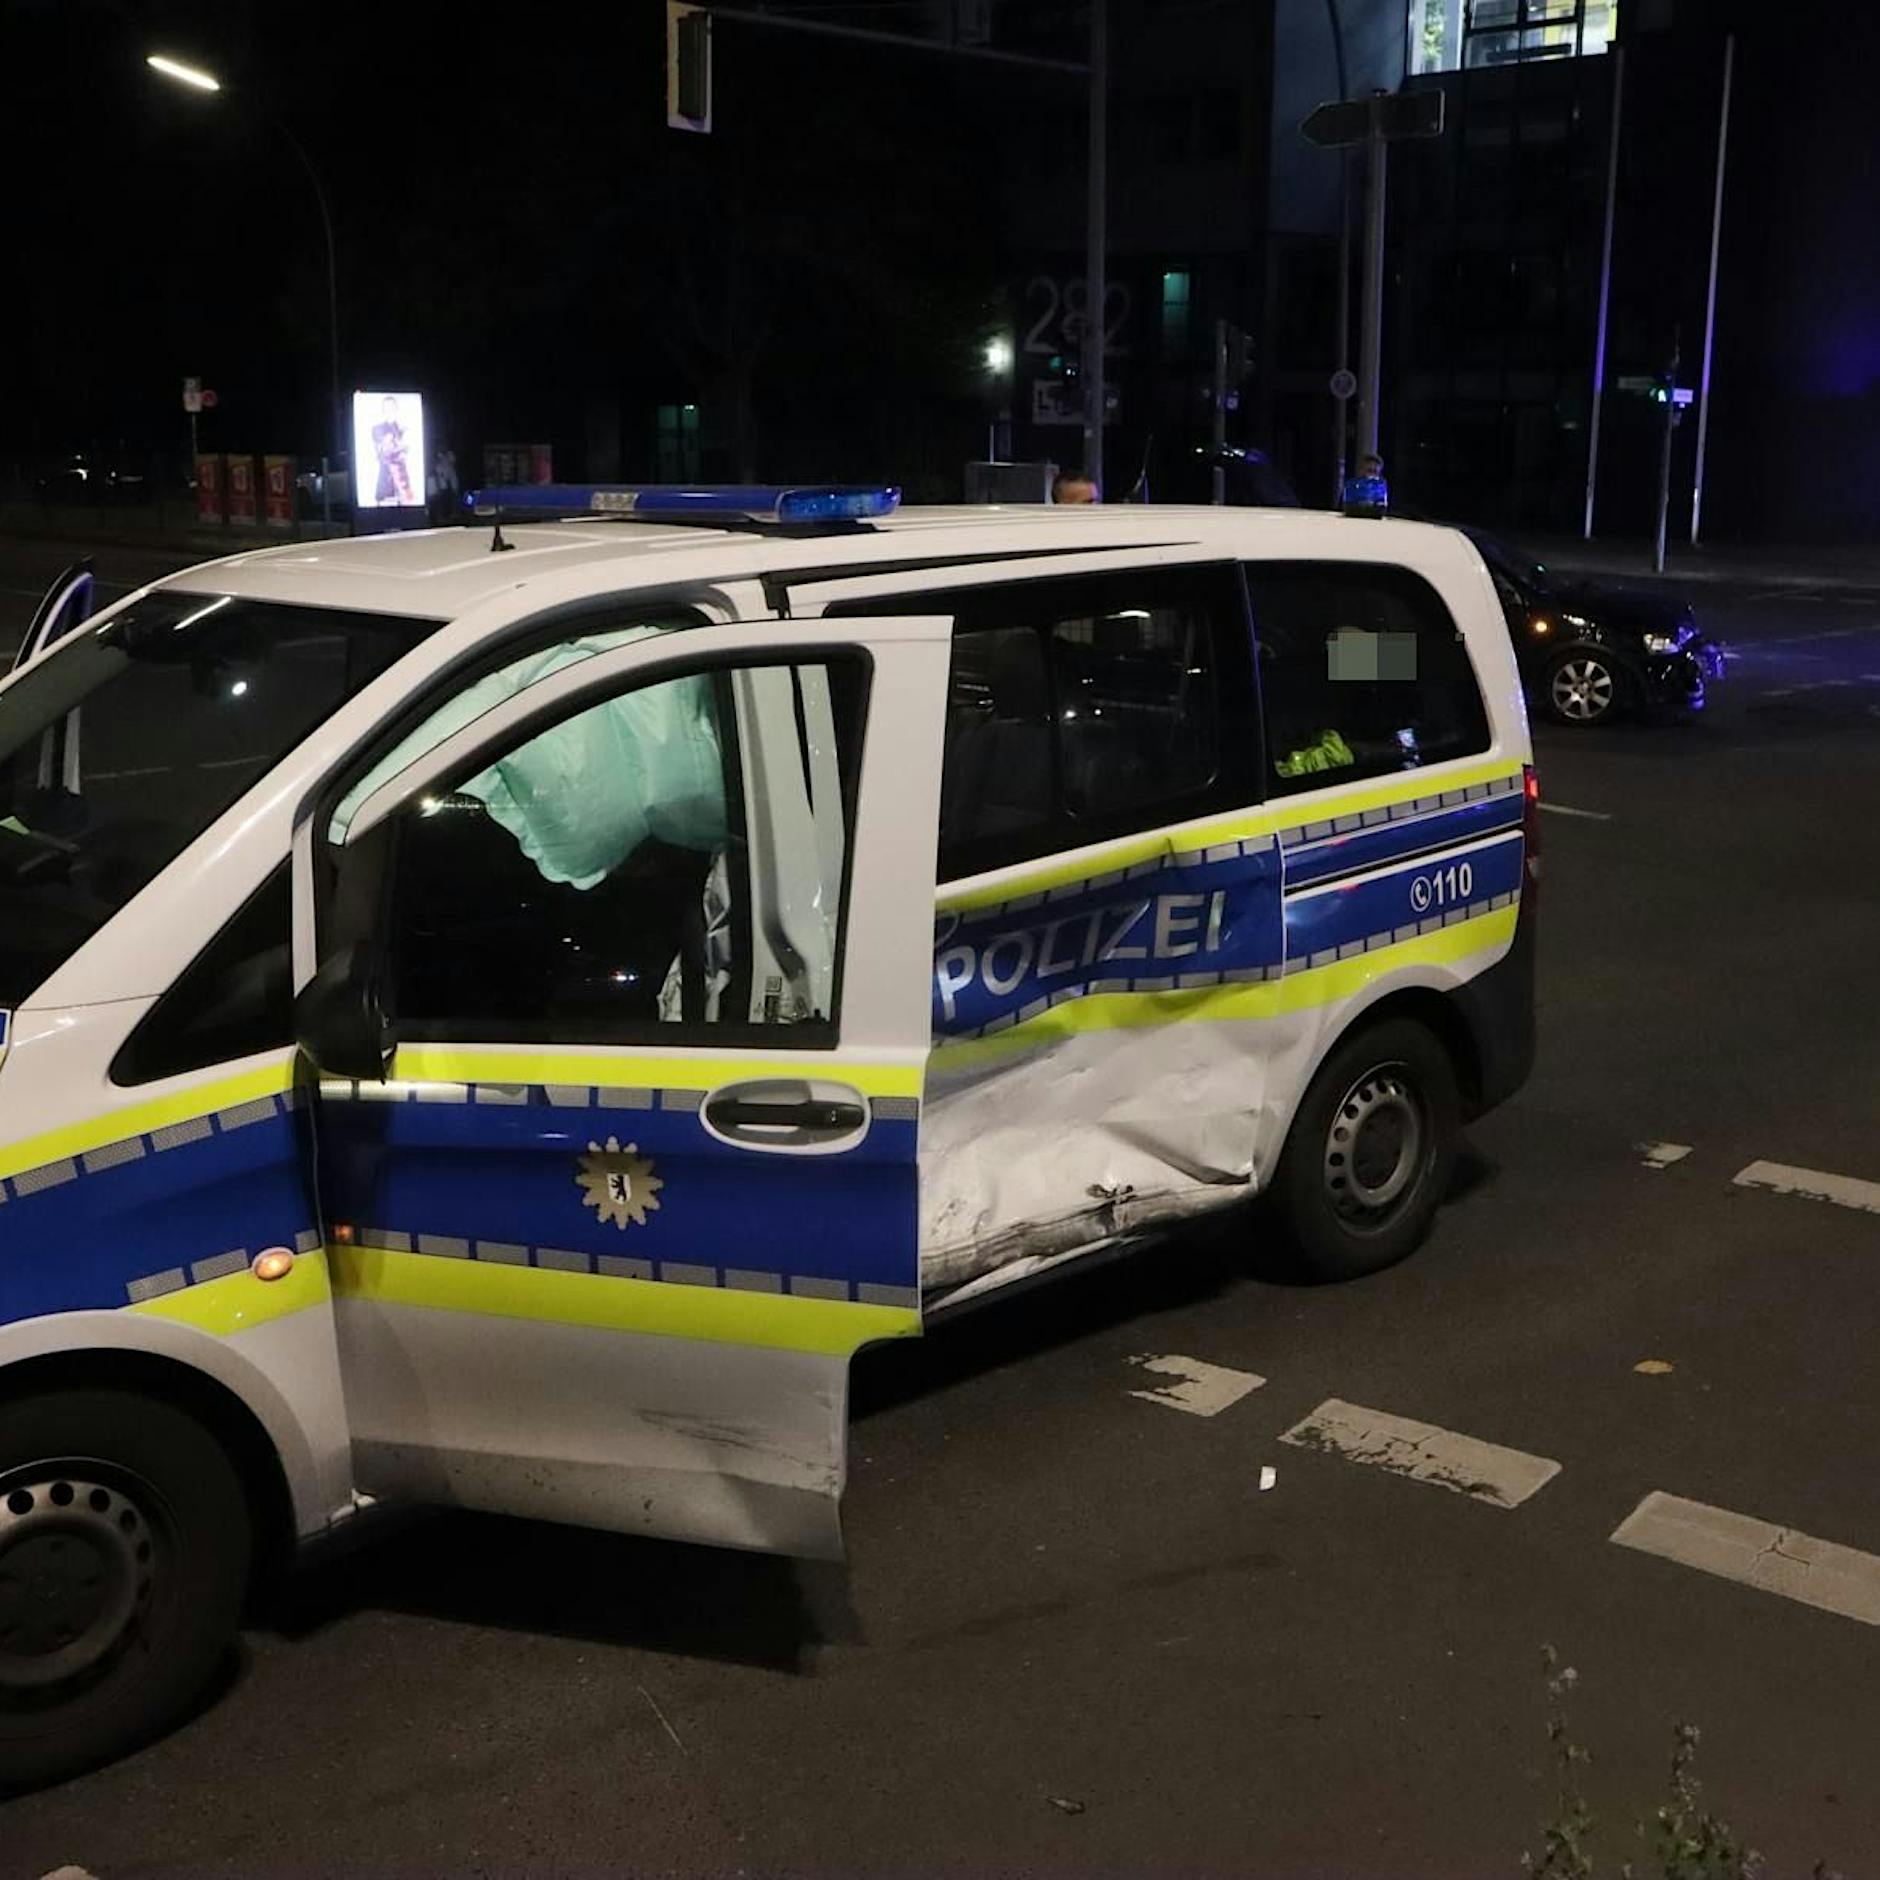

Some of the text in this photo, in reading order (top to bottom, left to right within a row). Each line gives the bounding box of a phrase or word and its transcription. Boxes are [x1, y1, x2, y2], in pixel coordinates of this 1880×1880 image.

[1024, 275, 1133, 356] 282
[1433, 862, 1473, 905] 110
[936, 891, 1227, 1021] POLIZEI
